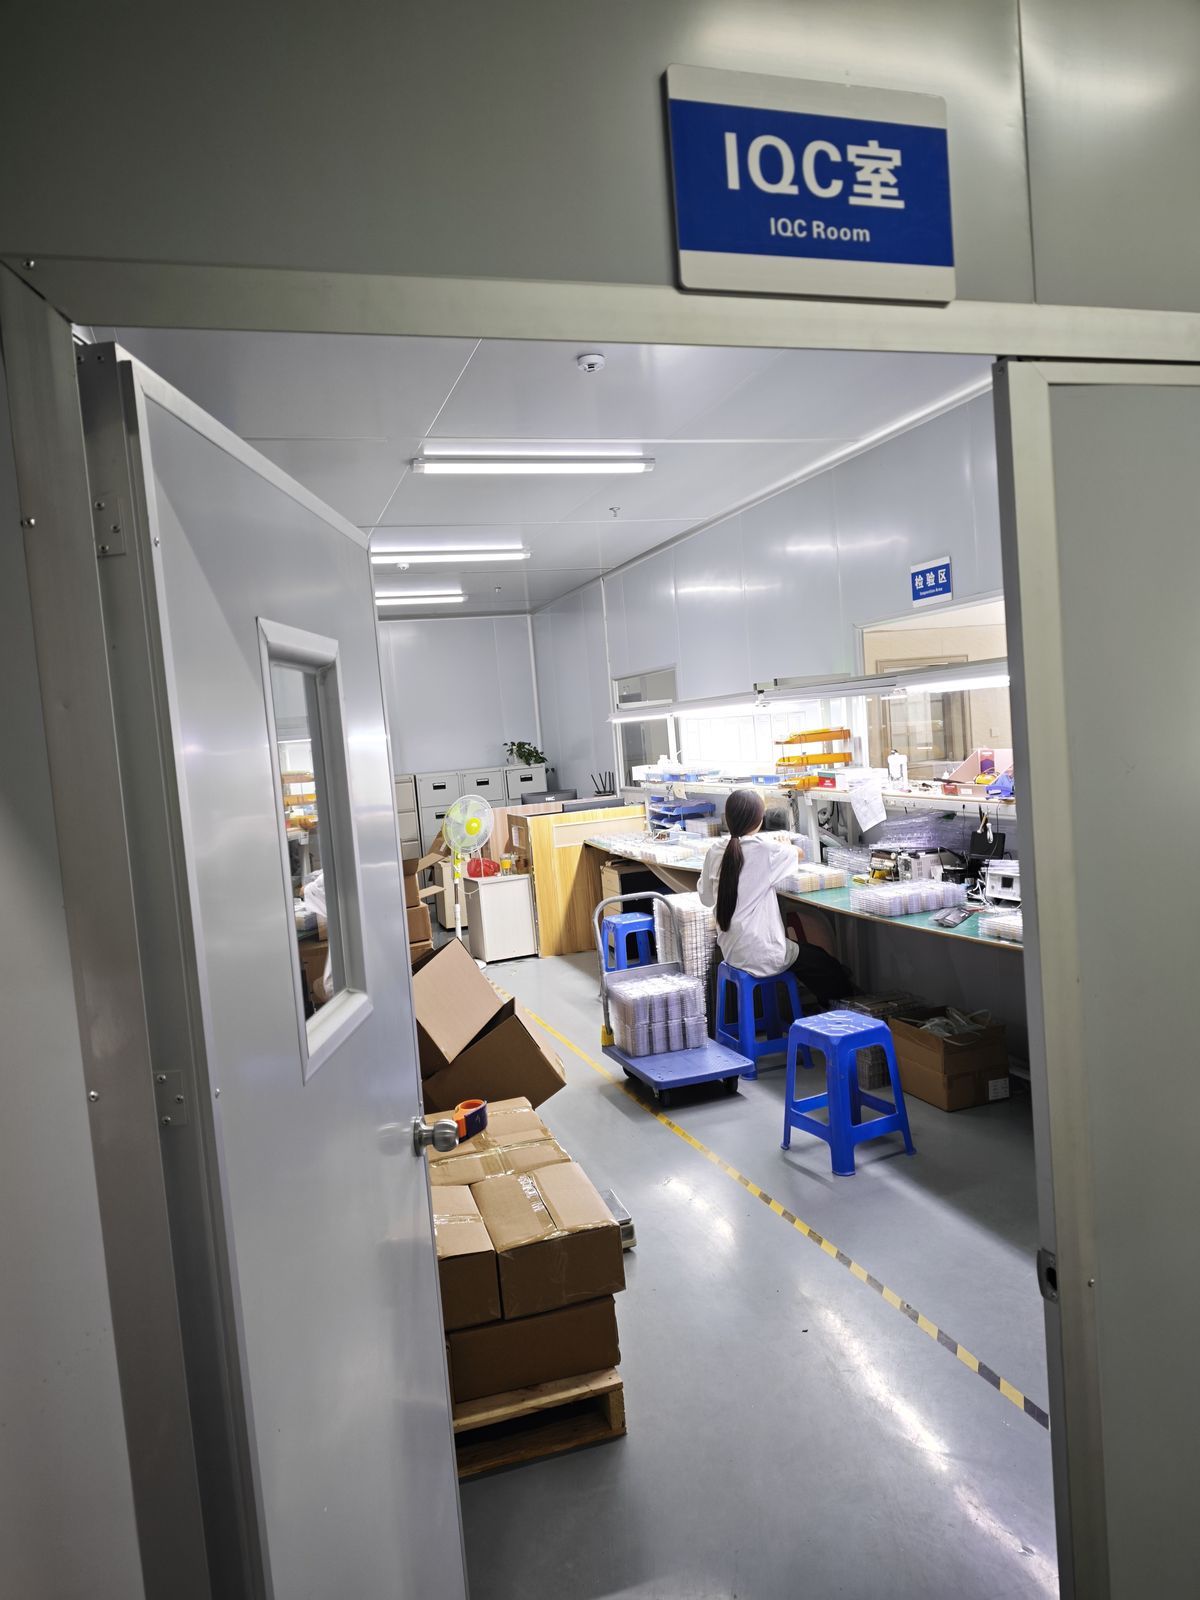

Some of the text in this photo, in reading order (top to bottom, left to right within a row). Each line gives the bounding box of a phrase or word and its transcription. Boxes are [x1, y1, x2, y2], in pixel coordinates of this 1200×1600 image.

[725, 132, 905, 209] IQC室
[770, 217, 871, 242] IQC Room
[914, 568, 947, 590] 检验区
